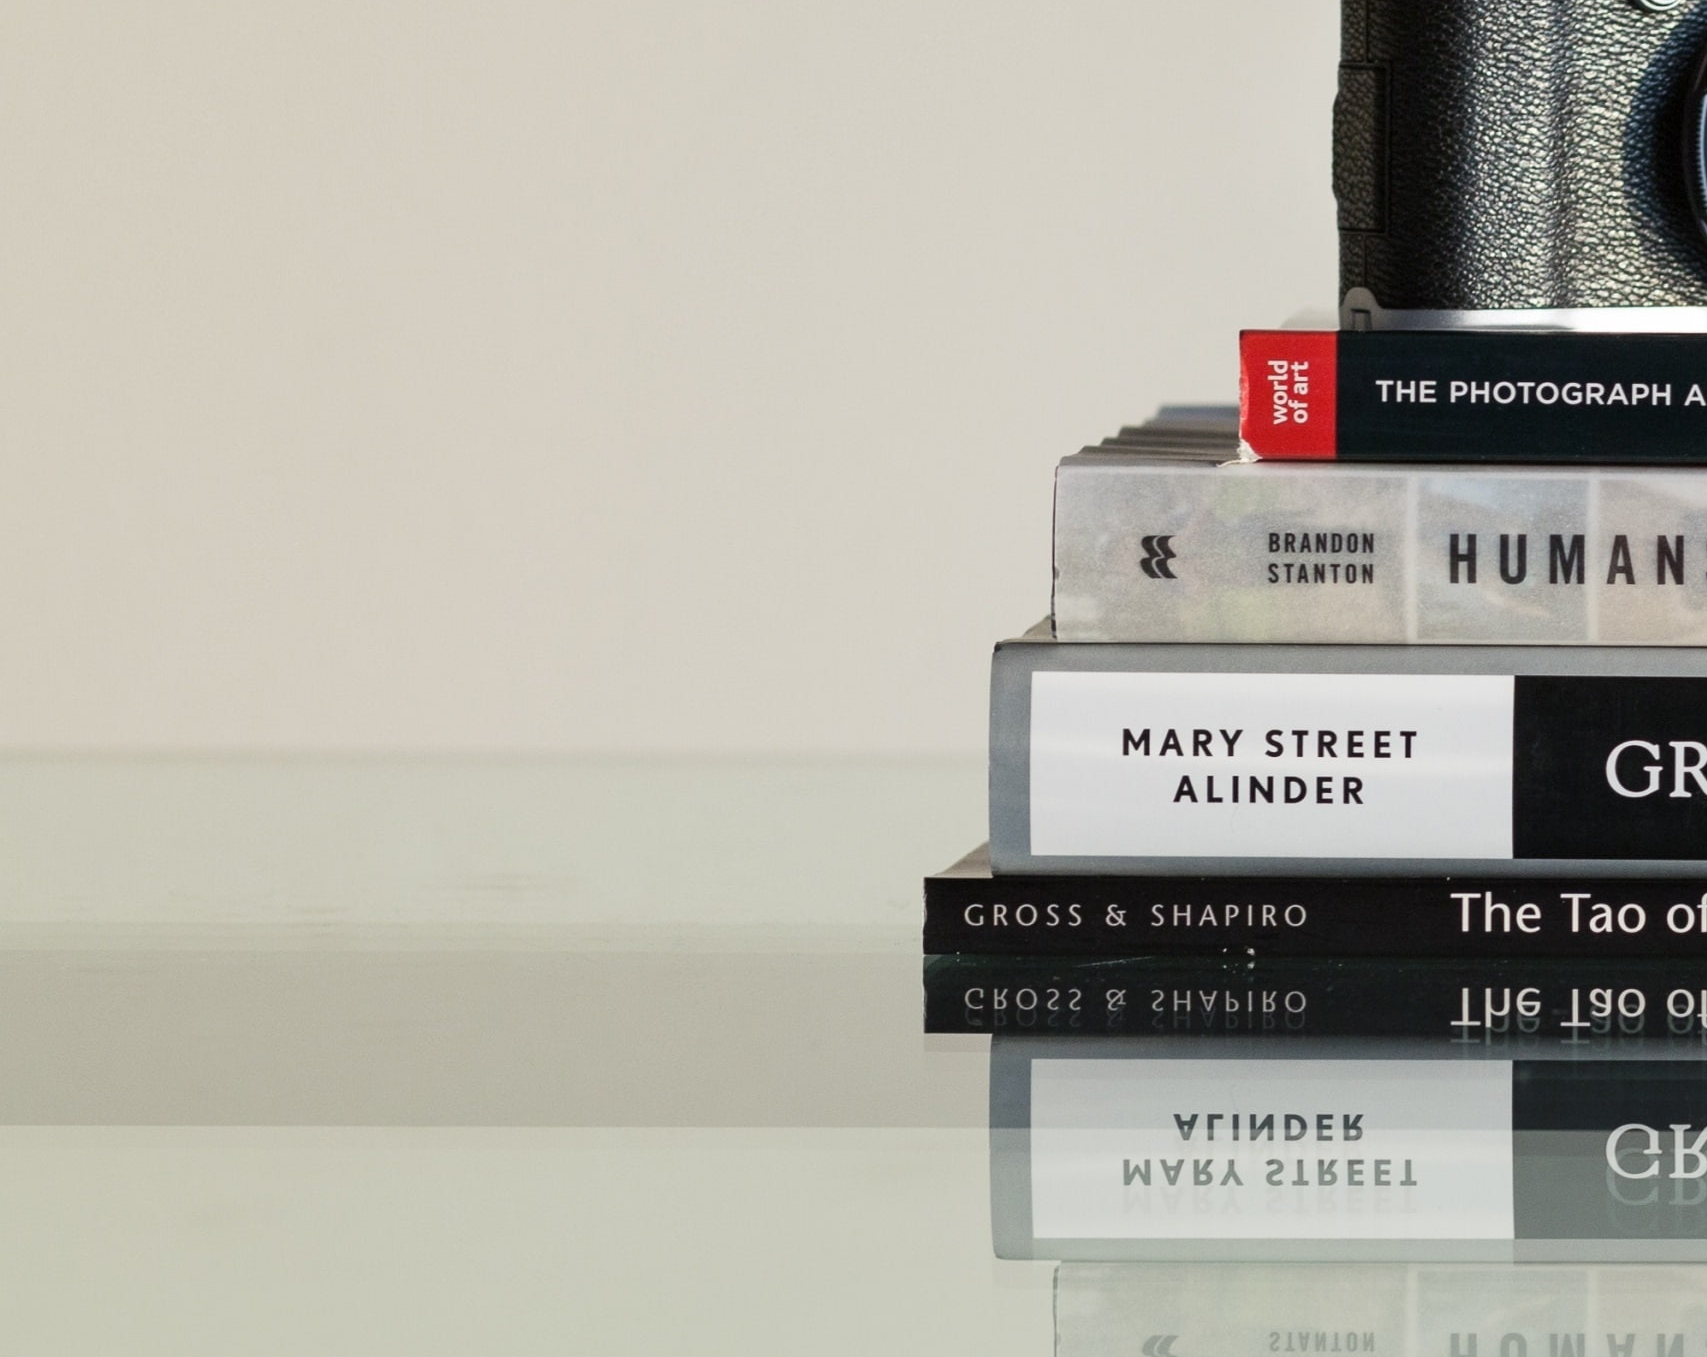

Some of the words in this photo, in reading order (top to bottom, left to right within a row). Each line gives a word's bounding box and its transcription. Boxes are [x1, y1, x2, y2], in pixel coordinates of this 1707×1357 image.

[1290, 361, 1309, 392] art
[1268, 360, 1289, 425] world
[1375, 379, 1437, 403] THE
[1450, 380, 1671, 406] PHOTOGRAPH
[1290, 398, 1309, 425] of
[1268, 532, 1374, 554] BRANDON
[1267, 562, 1374, 584] STANTON
[1122, 728, 1244, 757] MARY
[1265, 729, 1417, 759] STREET
[1173, 775, 1364, 805] ALINDER
[964, 903, 1082, 927] GROSS
[1105, 903, 1127, 927] &
[1151, 903, 1307, 927] SHAPIRO
[1450, 891, 1542, 933] The
[1560, 893, 1646, 934] Tao
